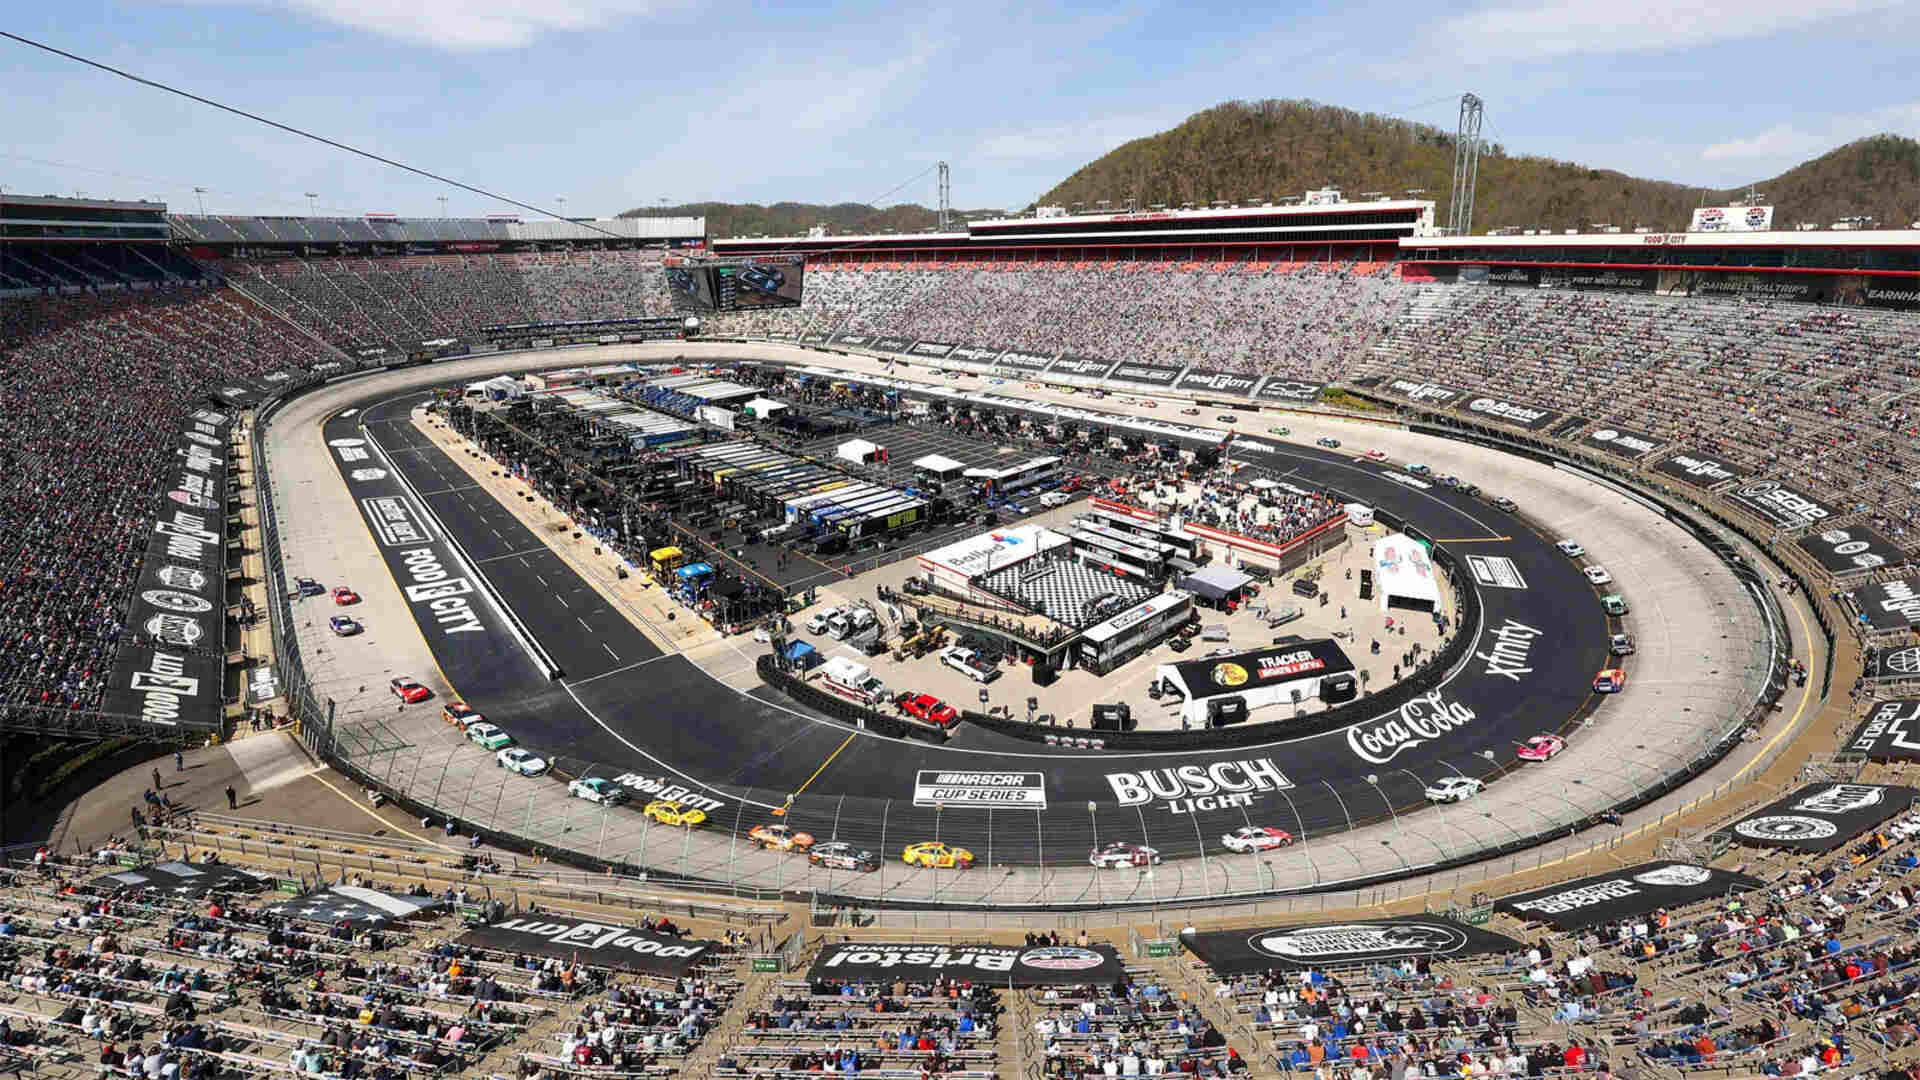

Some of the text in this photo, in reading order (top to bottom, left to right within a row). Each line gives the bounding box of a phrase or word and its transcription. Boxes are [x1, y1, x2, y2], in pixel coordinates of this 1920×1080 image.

[400, 547, 448, 582] FOOD
[430, 597, 485, 634] CITY
[1257, 650, 1316, 669] TRACKER
[1475, 618, 1544, 681] xfinity
[613, 772, 727, 812] FOOD CITY
[931, 788, 1029, 801] CUP SERIES
[957, 773, 1025, 787] NASCAR
[1105, 757, 1298, 808] BUSCH
[1167, 794, 1256, 814] LIGHT
[489, 917, 705, 958] FOOD CITY
[824, 950, 1020, 972] Bristol
